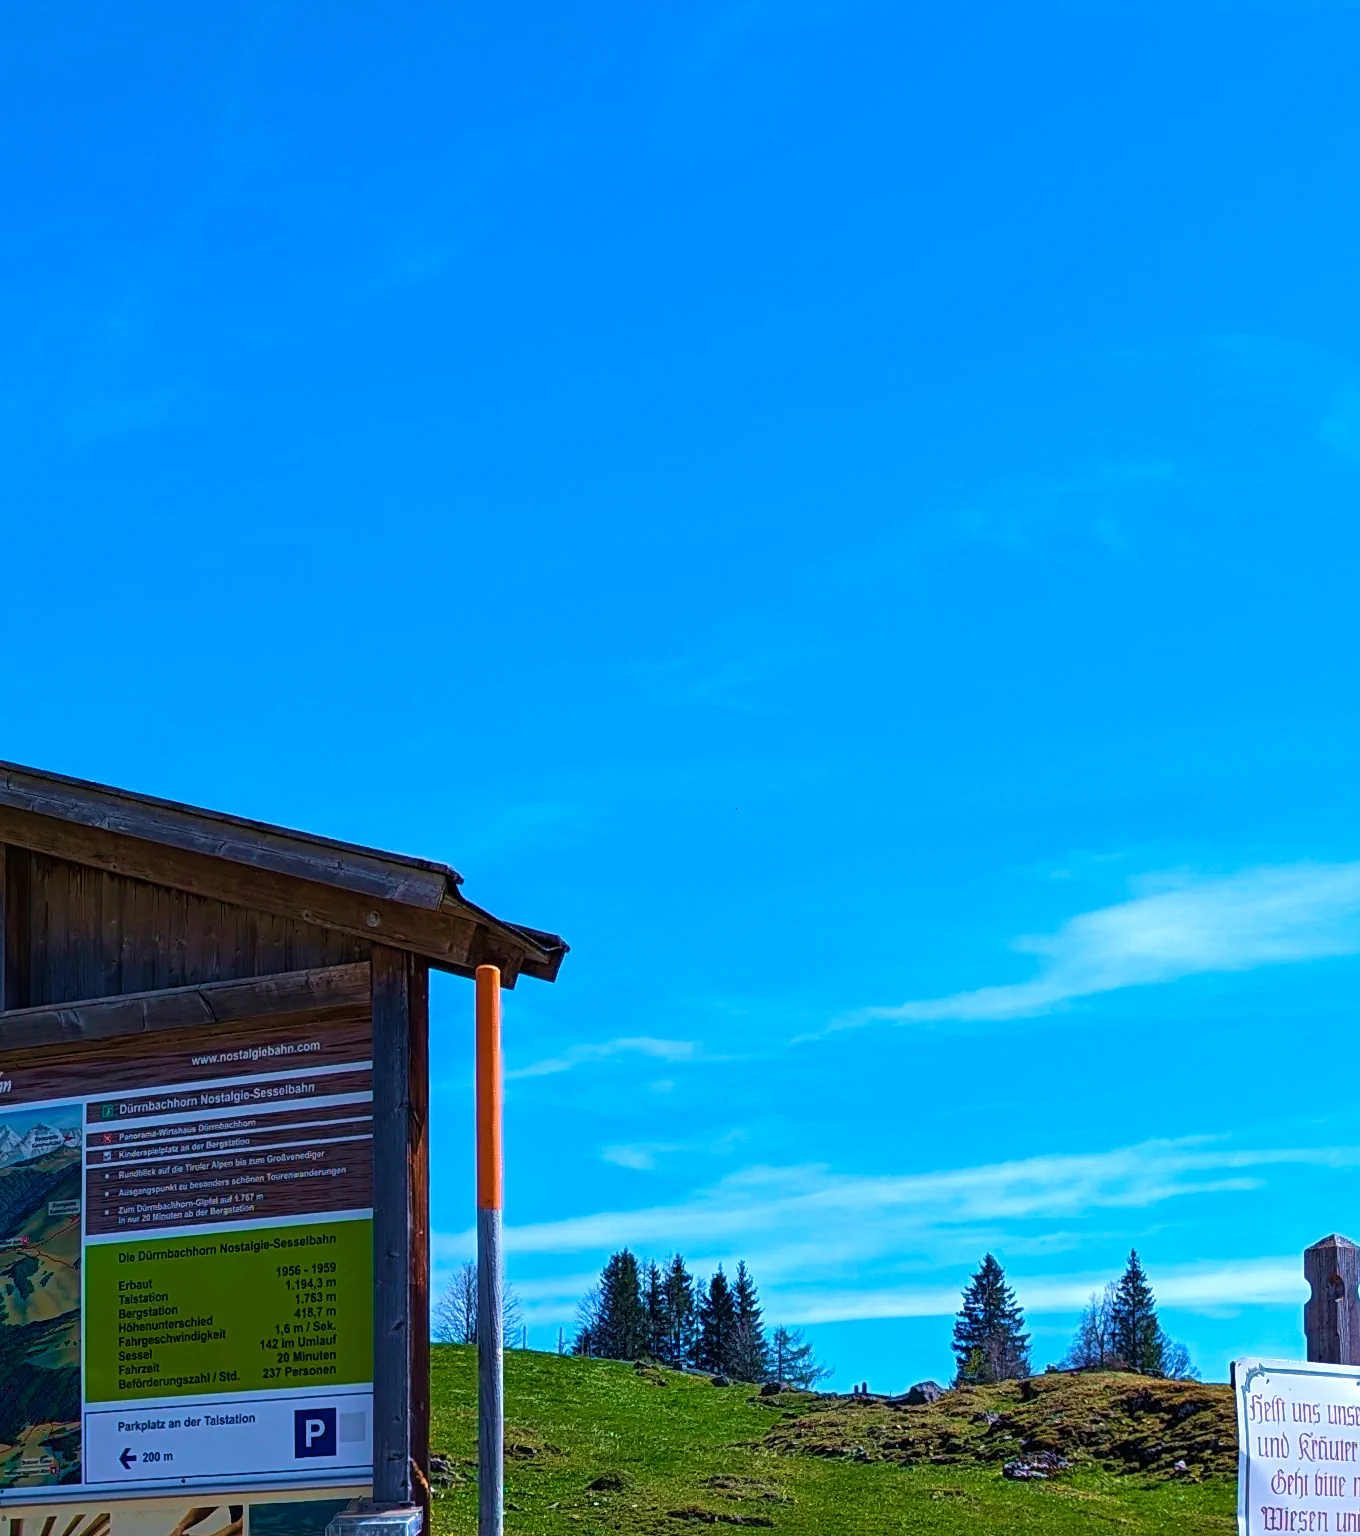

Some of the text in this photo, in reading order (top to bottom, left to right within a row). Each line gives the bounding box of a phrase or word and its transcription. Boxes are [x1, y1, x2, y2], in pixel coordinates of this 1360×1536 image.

[191, 1041, 321, 1067] www.nostalgiebahn.com
[119, 1082, 315, 1115] Dürrnbachhorn Nostalgie-Sesselbahn
[119, 1234, 337, 1264] Die Dürrnbachhorn Nostalgie-Sesselbahn
[276, 1263, 301, 1278] 1956
[311, 1261, 337, 1275] 1959
[119, 1279, 153, 1291] Erbaut
[285, 1278, 337, 1291] 1.194,3 m
[119, 1292, 169, 1306] Talstation
[326, 1293, 337, 1302] m
[119, 1305, 178, 1320] Bergstation
[294, 1307, 337, 1319] 418,7 m
[119, 1315, 214, 1334] Höhenunterschied
[275, 1323, 291, 1336] 1,6
[293, 1324, 304, 1333] m
[312, 1320, 337, 1332] Sek.
[119, 1328, 227, 1349] Fahrgeschwindigkeit
[260, 1333, 338, 1350] 142 im Umlauf
[119, 1349, 153, 1361] Sessel
[277, 1349, 337, 1364] 20 Minuten
[119, 1362, 160, 1376] Fahrzeit
[262, 1364, 337, 1379] 237 Personen
[119, 1373, 211, 1391] Beförderungszahl
[218, 1370, 240, 1383] Std.
[1249, 1394, 1287, 1428] Helft
[1292, 1401, 1321, 1426] uns
[117, 1412, 256, 1433] Parkplatz an der Talstation
[305, 1418, 326, 1447] P
[1257, 1432, 1290, 1459] und
[1298, 1431, 1358, 1463] Kräuter
[142, 1451, 174, 1463] 200 m
[1271, 1468, 1309, 1500] Geht
[1314, 1467, 1347, 1498] bitte
[1261, 1506, 1329, 1534] Wiesen
